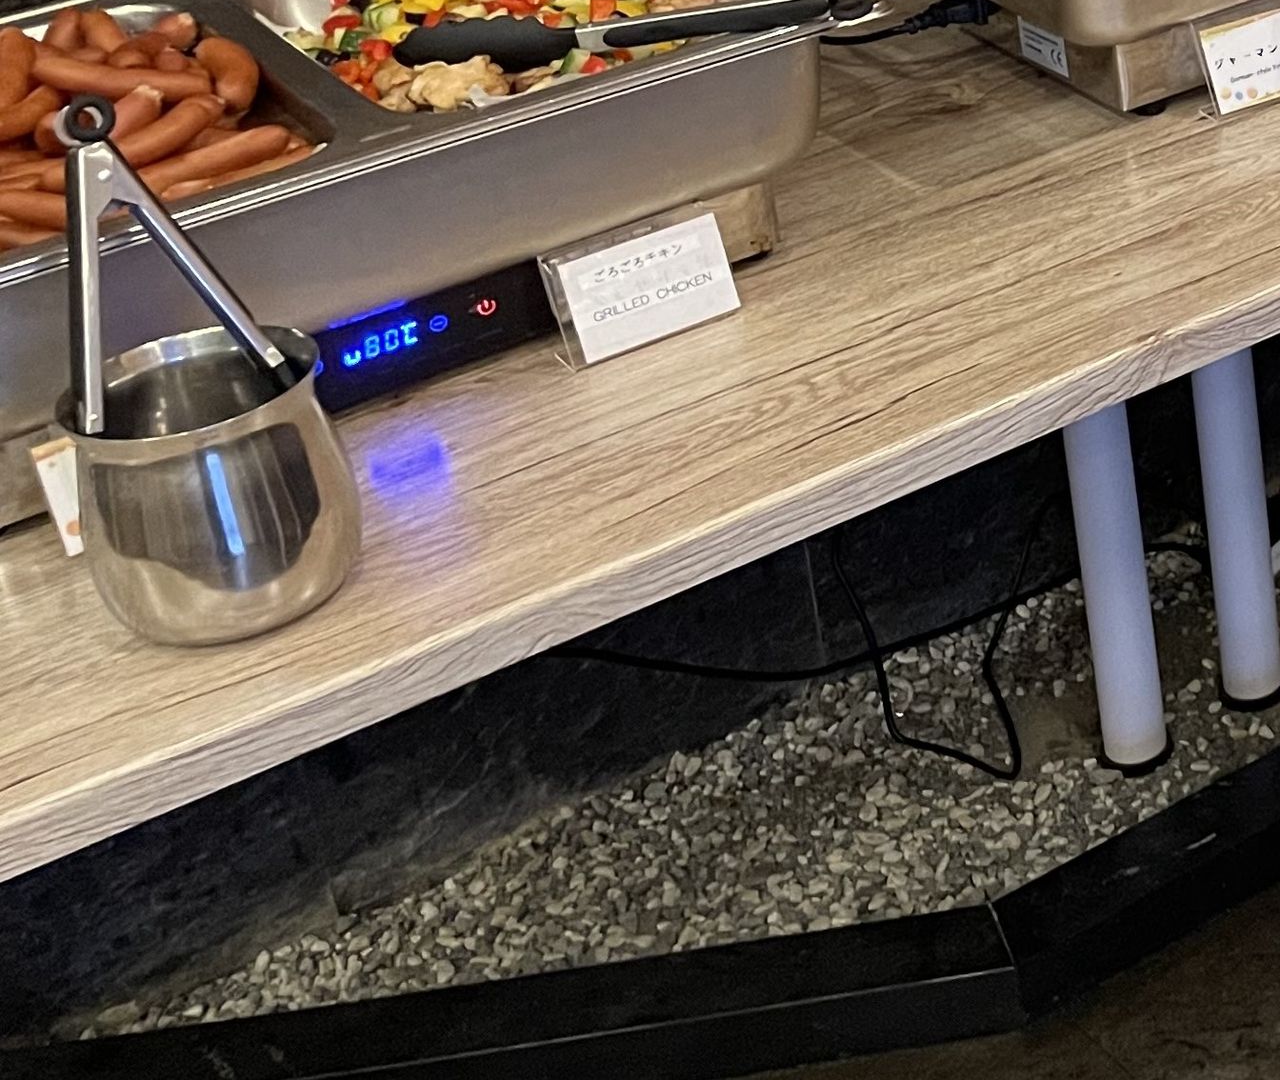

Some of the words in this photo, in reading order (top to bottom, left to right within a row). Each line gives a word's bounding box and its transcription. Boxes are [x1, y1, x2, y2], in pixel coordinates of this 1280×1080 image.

[593, 242, 683, 284] ごろごろチキン
[592, 293, 651, 323] GRILLED
[655, 270, 713, 300] CHICKEN
